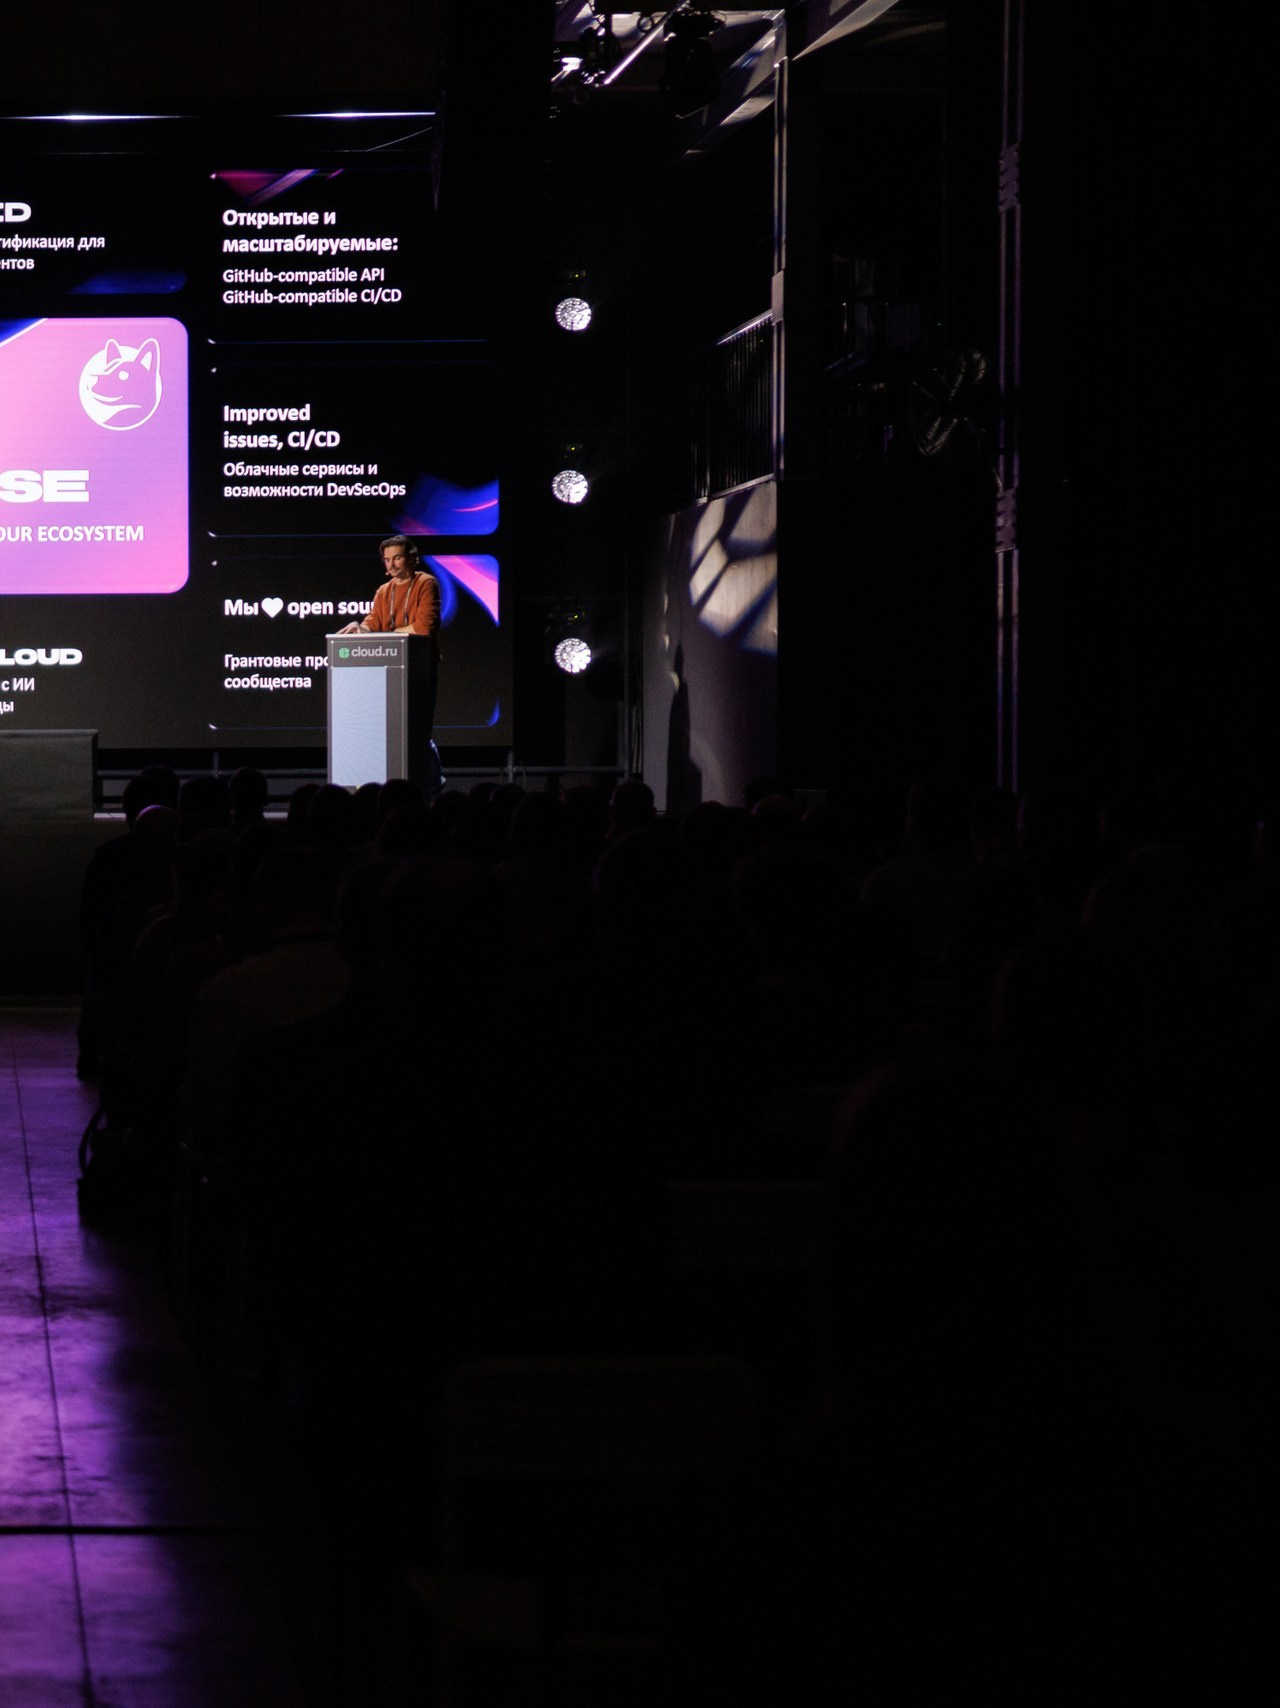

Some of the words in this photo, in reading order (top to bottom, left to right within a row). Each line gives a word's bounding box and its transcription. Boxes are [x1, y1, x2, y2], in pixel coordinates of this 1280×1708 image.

[223, 210, 319, 229] Открытые
[323, 211, 336, 225] и
[78, 237, 105, 250] для
[223, 235, 398, 255] масштабируемые:
[223, 267, 357, 285] GitHub-compatible
[361, 268, 384, 281] API
[223, 288, 357, 306] GitHub-compatible
[361, 288, 401, 304] CI/CD
[224, 404, 310, 425] Improved
[224, 431, 283, 450] issues,
[288, 429, 340, 450] CI/CD
[224, 462, 299, 476] Облачные
[302, 464, 364, 478] сервисы
[367, 463, 378, 475] и
[224, 486, 323, 497] возможности
[328, 482, 406, 498] DevSecOps
[38, 526, 143, 541] ECOSYSTEM
[225, 599, 258, 615] Мы
[288, 602, 333, 618] open
[351, 646, 397, 657] cloud.ru
[225, 654, 301, 670] Грантовые
[0, 680, 10, 692] с
[13, 678, 34, 691] ИИ
[224, 674, 311, 690] сообщества
